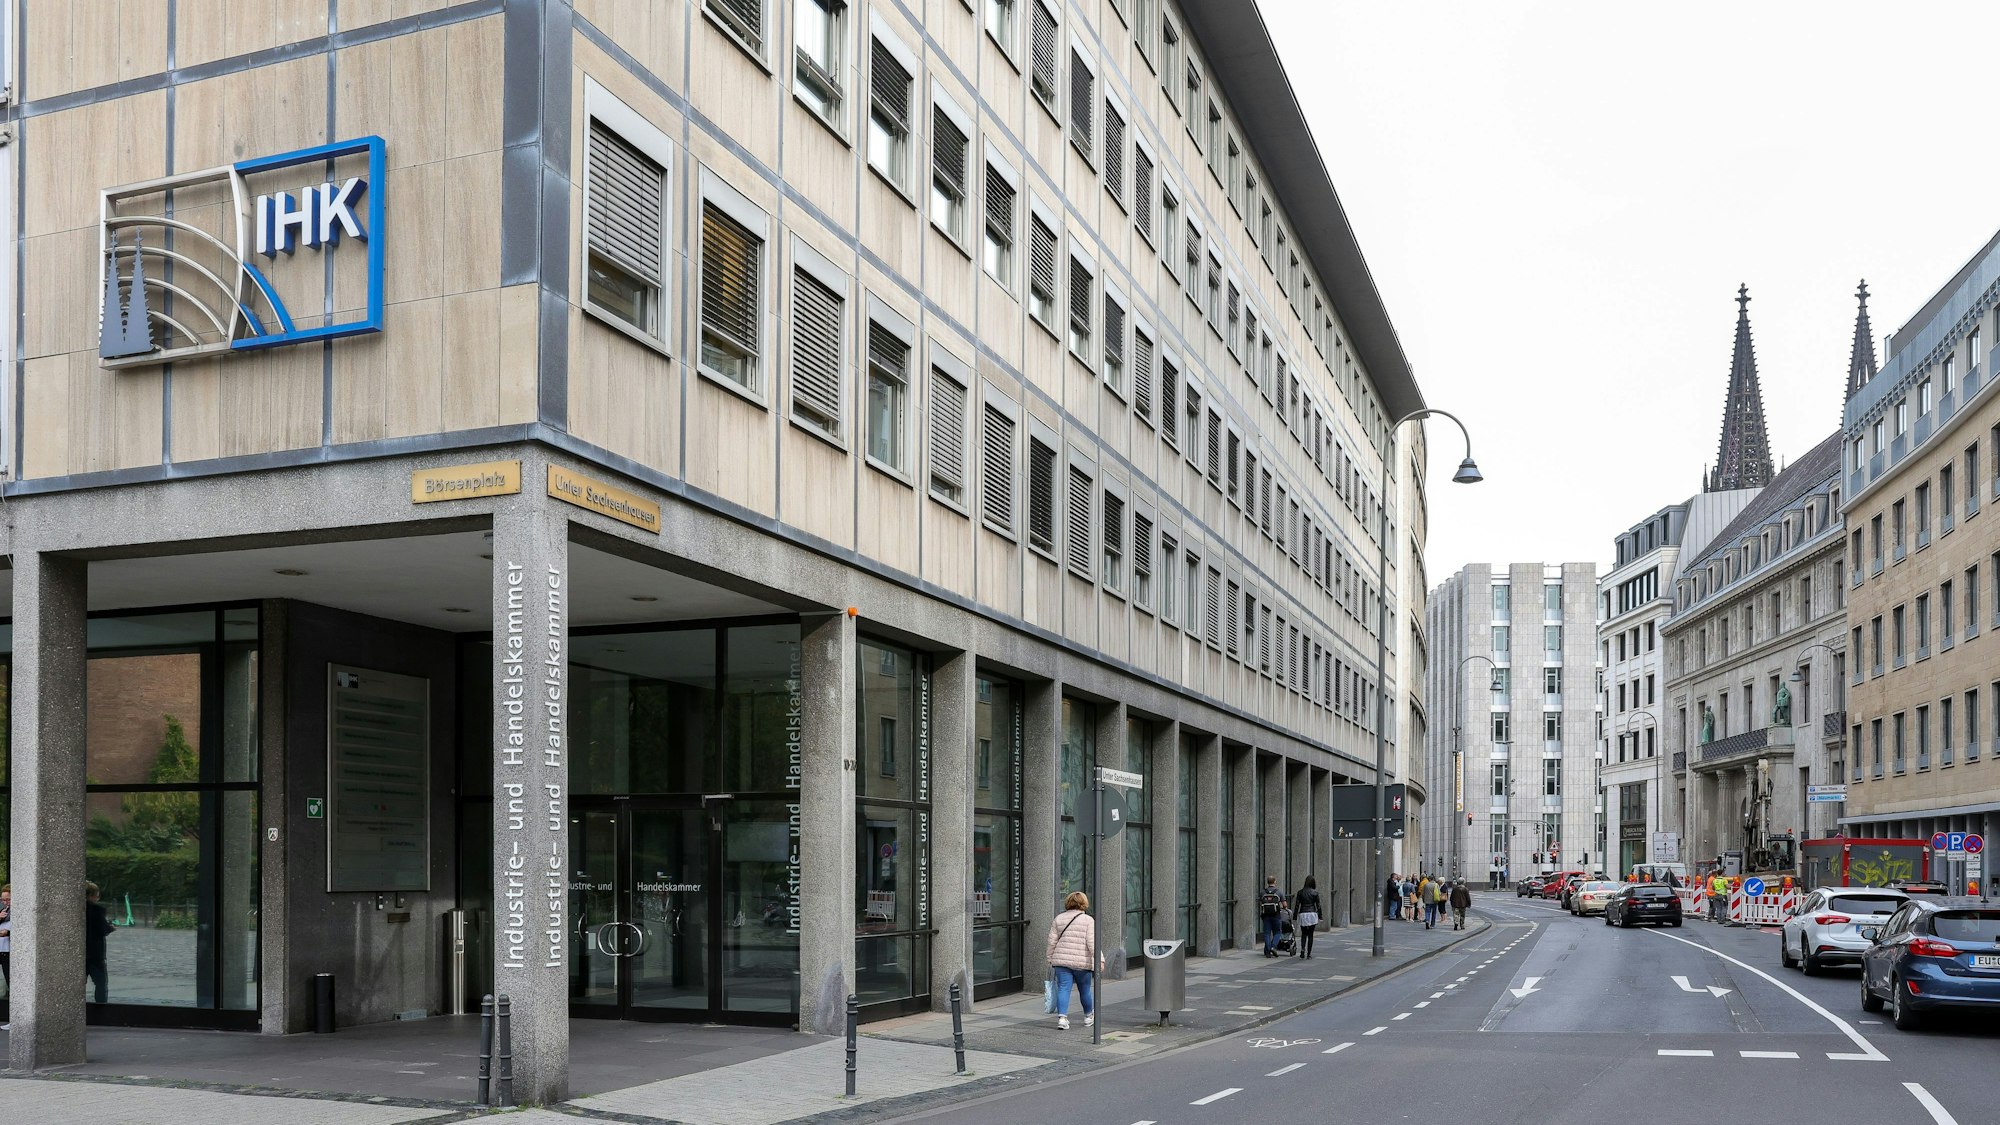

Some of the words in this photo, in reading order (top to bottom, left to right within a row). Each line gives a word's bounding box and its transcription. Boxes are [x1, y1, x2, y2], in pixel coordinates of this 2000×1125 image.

[257, 177, 366, 257] IHK
[425, 471, 505, 494] Börsenplatz
[555, 474, 582, 498] Unter
[586, 487, 656, 523] Sachsenhausen
[503, 561, 524, 765] Handelskammer
[545, 564, 561, 767] Handelskammer
[919, 675, 929, 801] Handelskammer
[1103, 769, 1114, 781] Unter
[1114, 773, 1142, 786] Sachsenhausen
[503, 783, 524, 830] und
[545, 784, 561, 831] und
[786, 804, 800, 837] und
[919, 813, 927, 842] und
[1951, 835, 1962, 849] P
[503, 841, 524, 968] Industrie-
[545, 842, 561, 968] Industrie-
[568, 881, 595, 890] ustrie-
[598, 881, 612, 891] und
[637, 881, 701, 892] Handelskammer
[786, 845, 800, 934] Industrie-
[919, 849, 927, 926] Industrie-
[1978, 957, 1991, 965] EU
